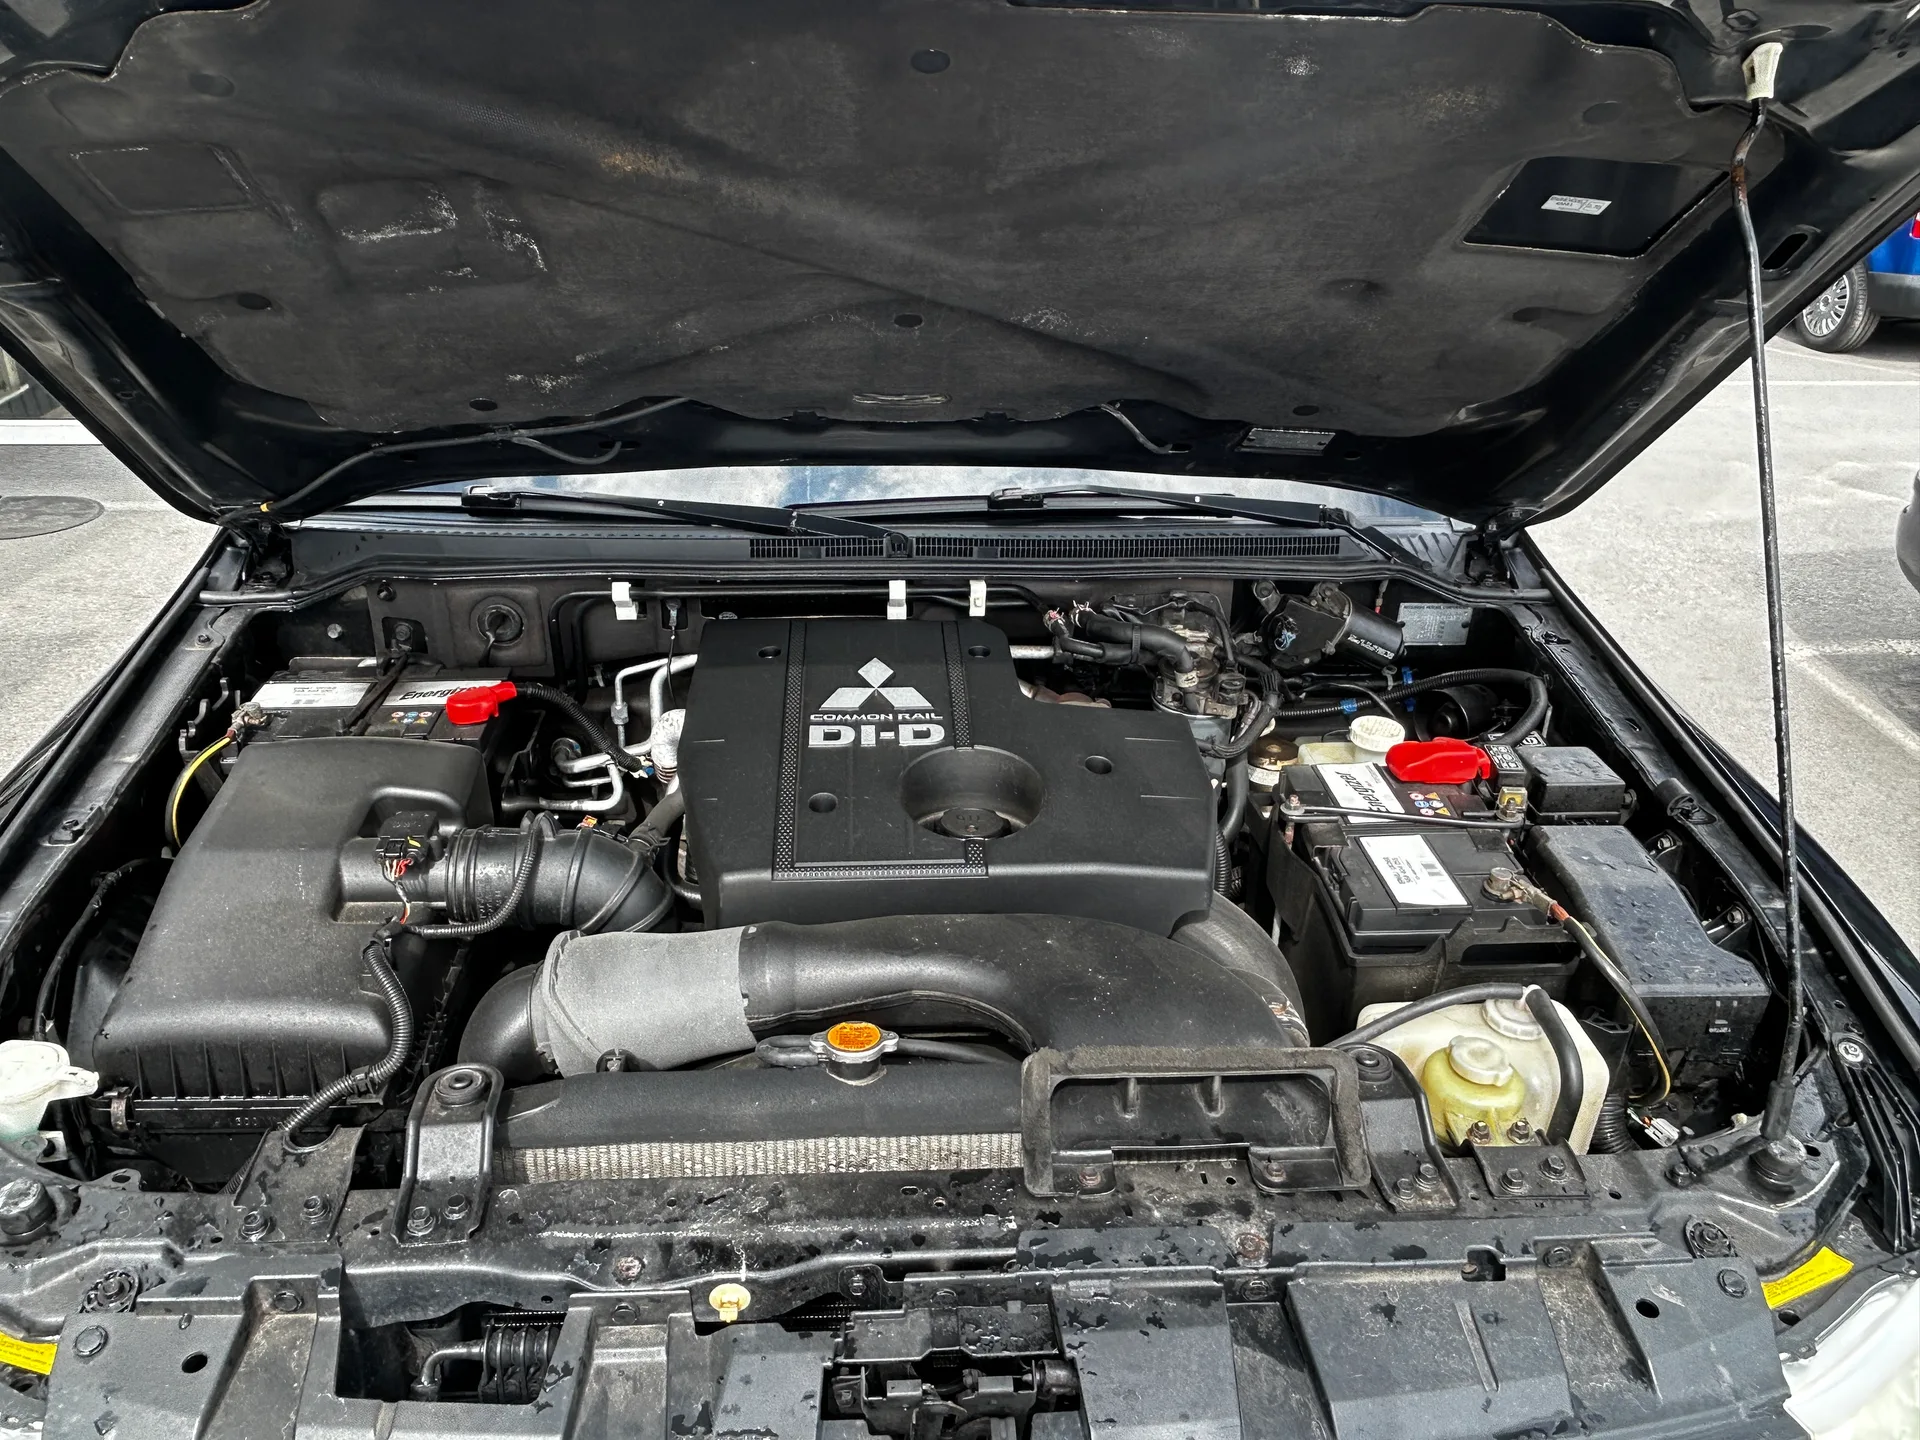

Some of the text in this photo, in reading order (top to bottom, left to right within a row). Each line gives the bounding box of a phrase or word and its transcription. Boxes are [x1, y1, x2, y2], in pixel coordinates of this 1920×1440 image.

[810, 712, 943, 721] COMMON RAIL
[808, 723, 945, 747] DI-D
